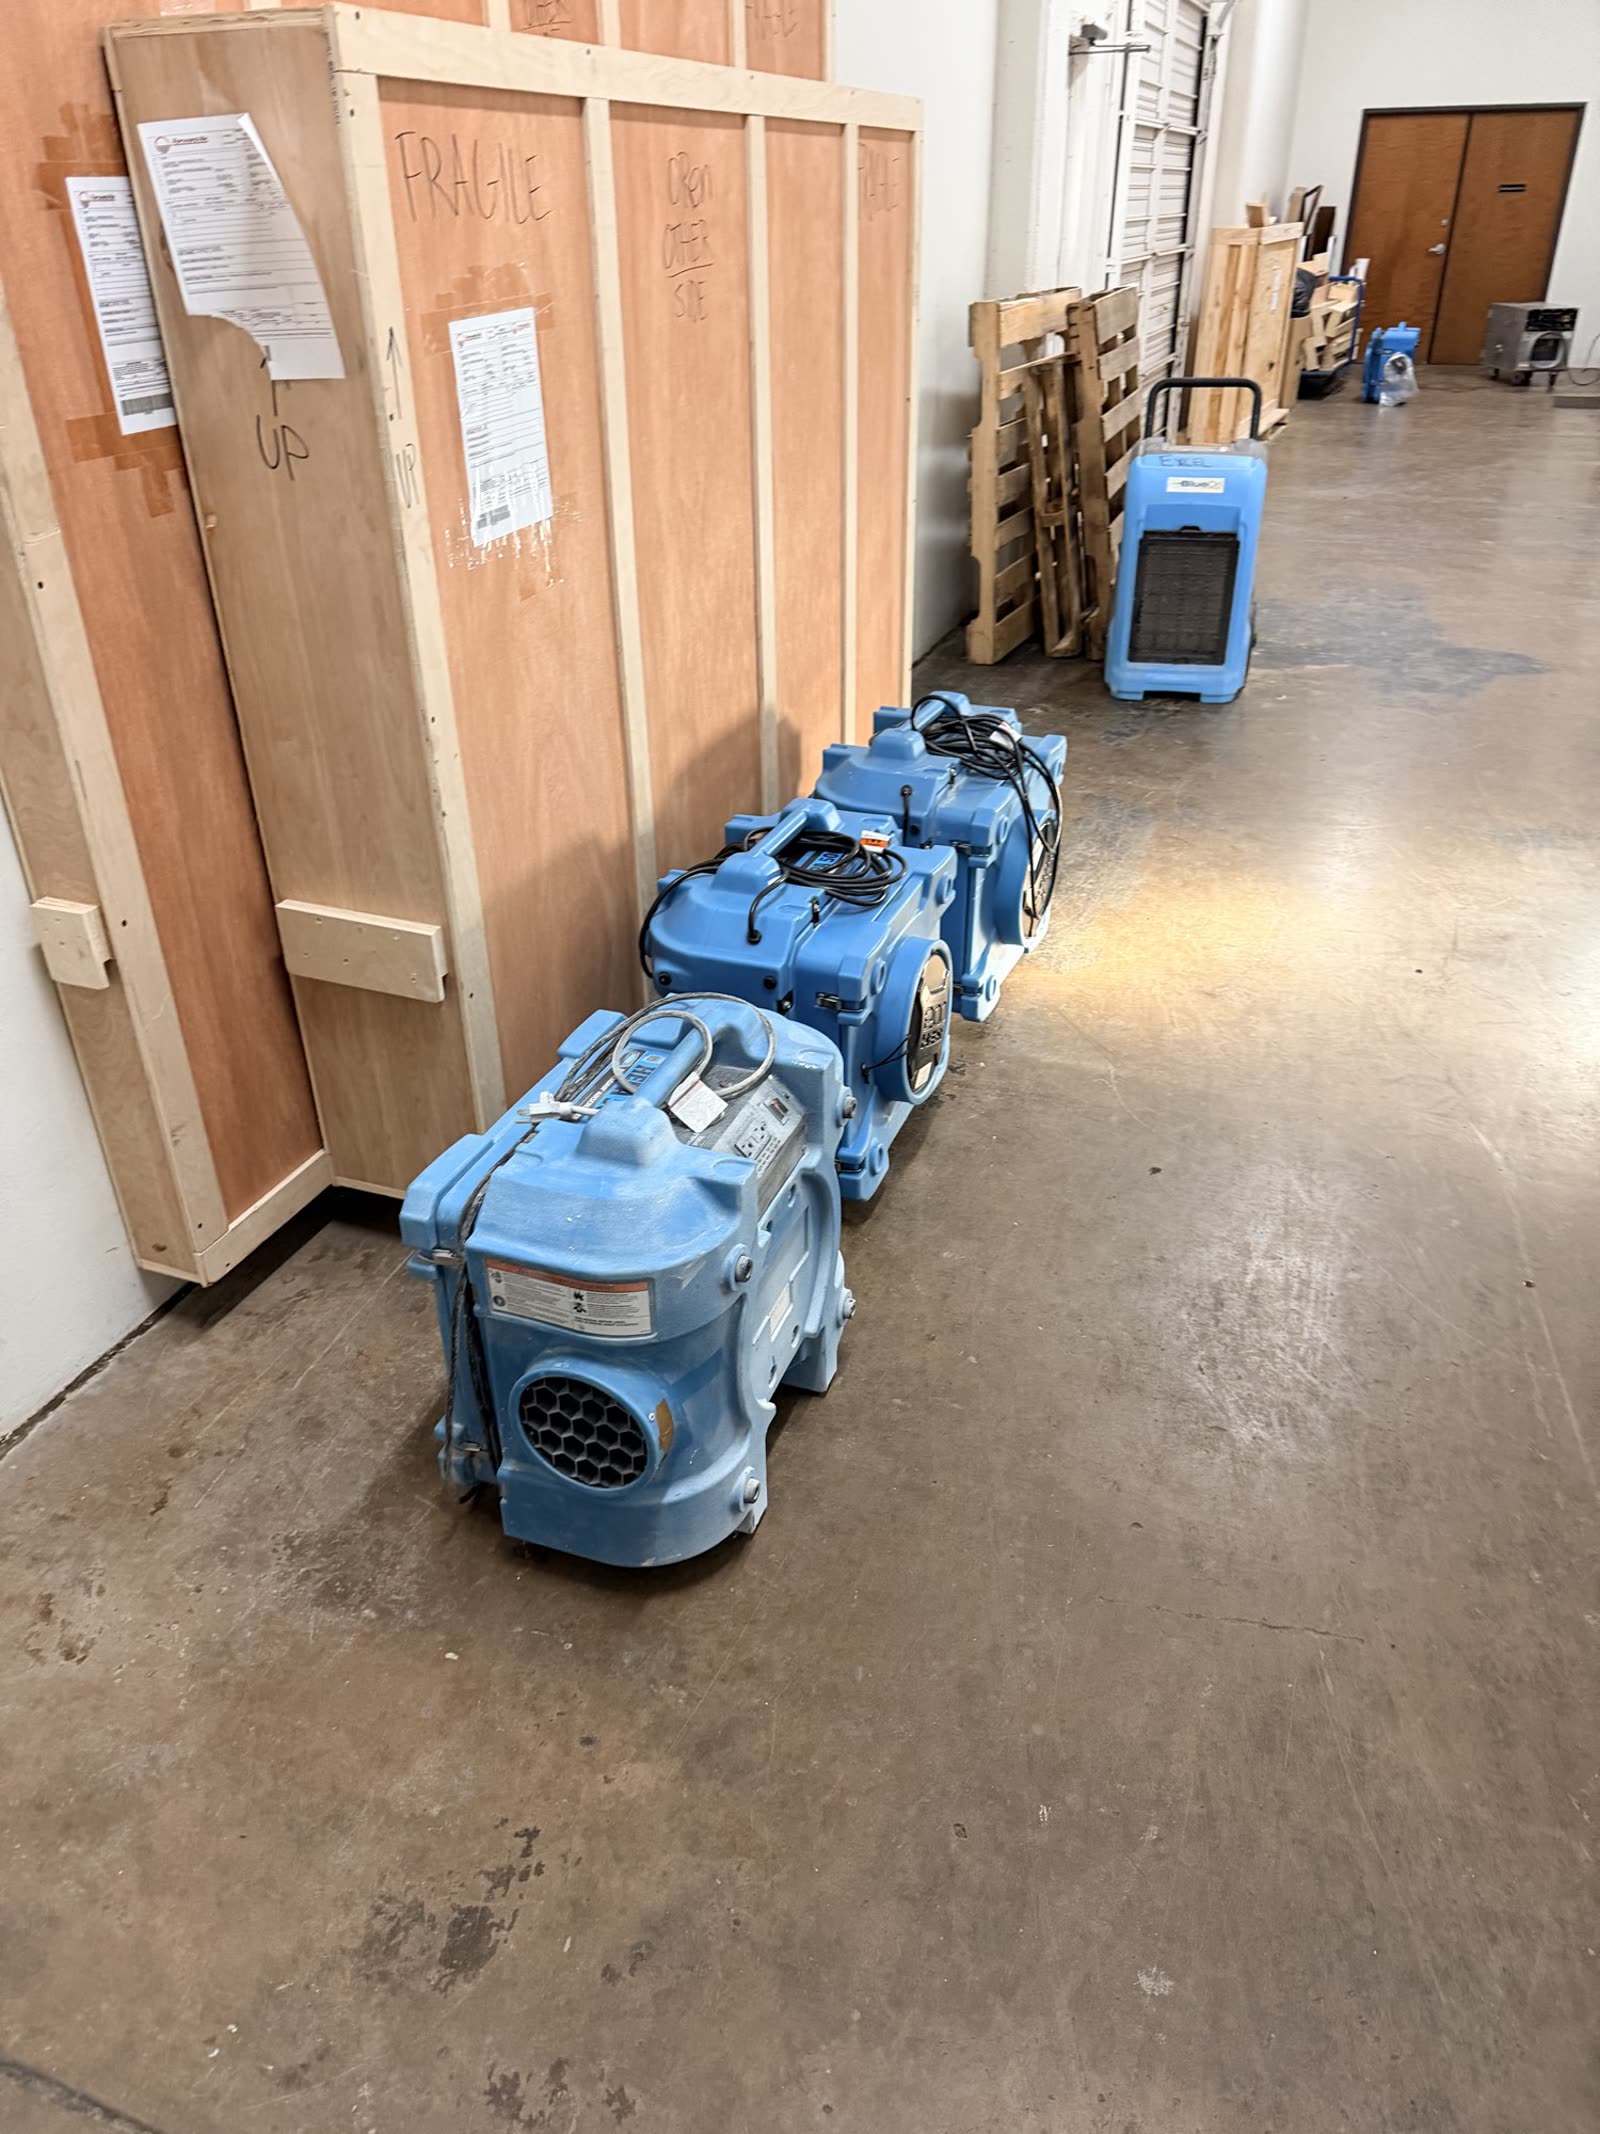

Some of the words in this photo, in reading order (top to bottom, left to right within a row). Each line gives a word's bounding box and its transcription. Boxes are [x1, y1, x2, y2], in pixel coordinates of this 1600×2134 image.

[395, 131, 552, 225] FRAGILE
[256, 415, 309, 481] UP
[396, 443, 421, 509] UP
